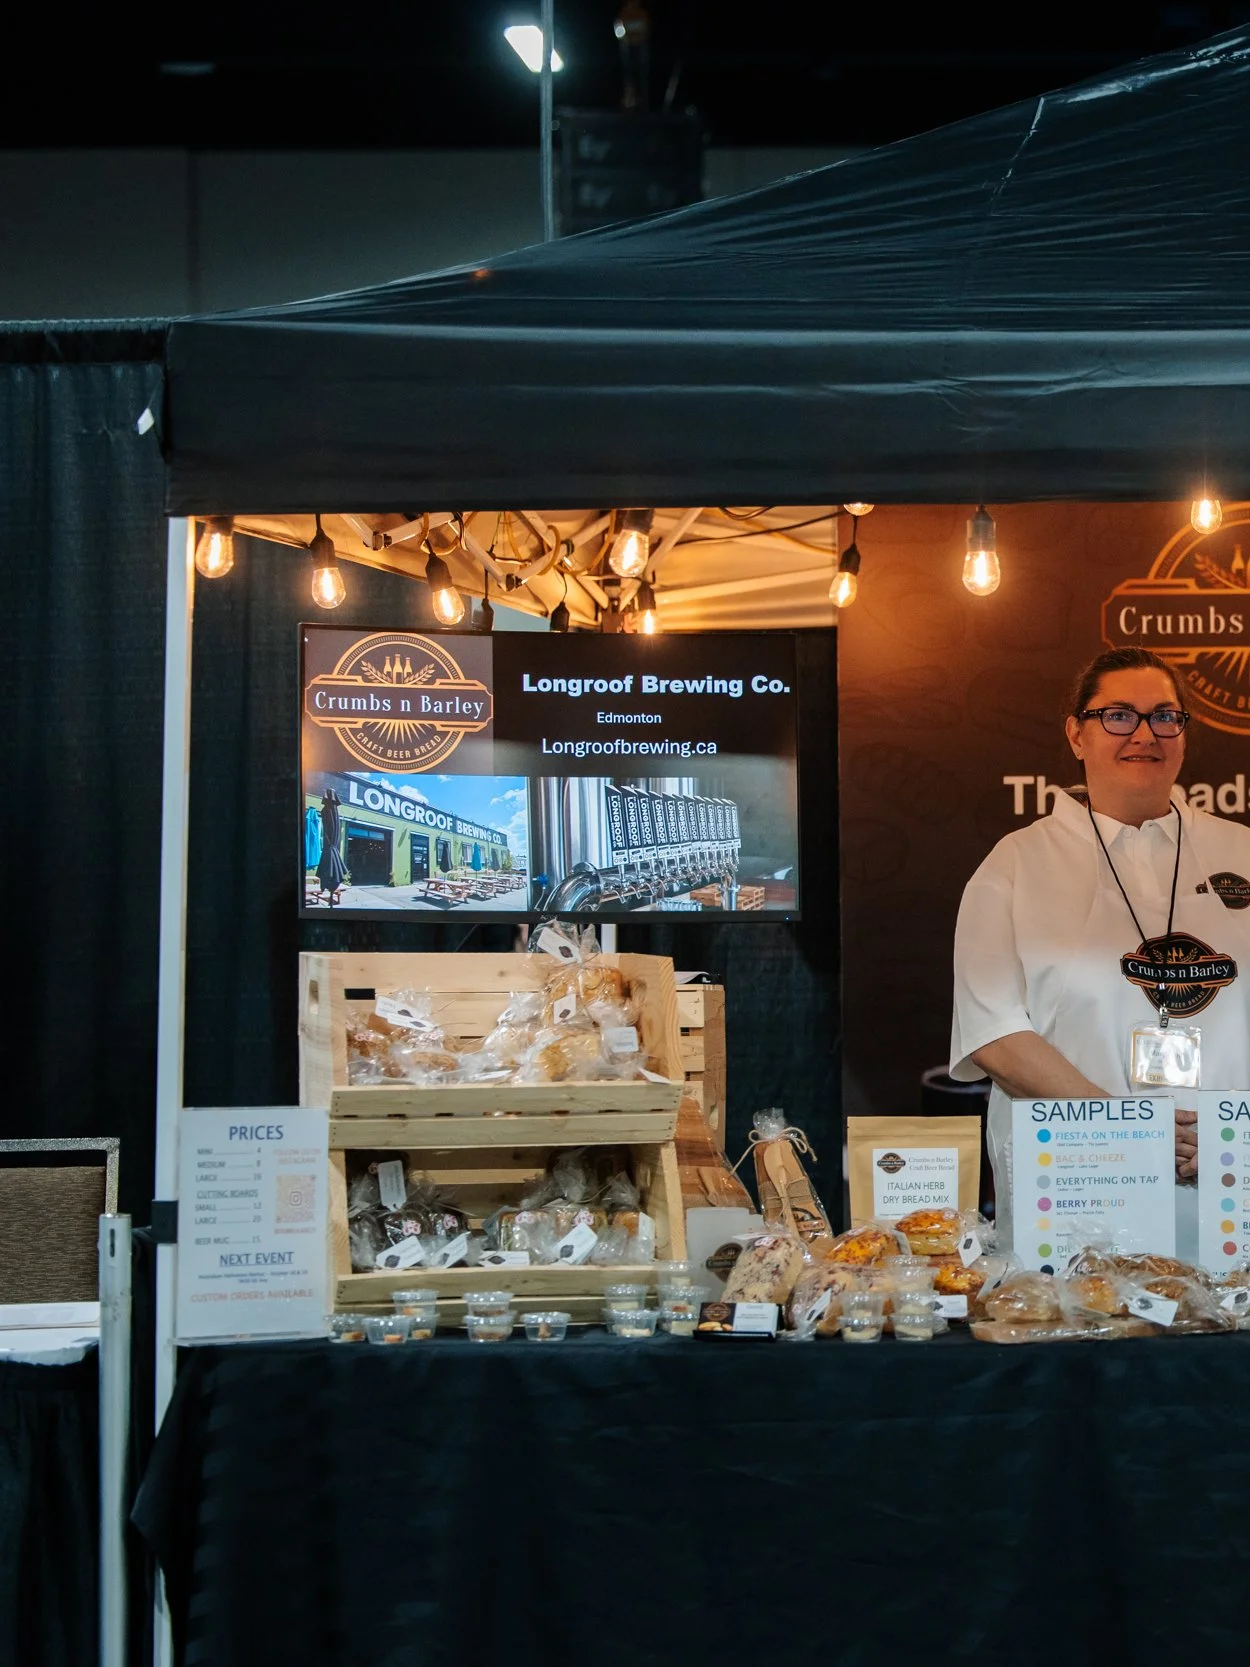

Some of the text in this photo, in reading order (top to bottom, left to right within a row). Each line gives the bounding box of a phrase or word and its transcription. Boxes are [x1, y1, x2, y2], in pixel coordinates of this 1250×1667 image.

[1119, 606, 1244, 635] Crumbs
[523, 674, 790, 698] Longroof Brewing Co.
[1188, 669, 1230, 704] CRAFT
[315, 691, 483, 719] Crumbs n Barley
[597, 712, 662, 724] Edmonton
[356, 732, 441, 759] CRAFT BEER BREAD
[542, 738, 717, 758] Longroofbrewing.ca
[1003, 775, 1088, 815] Th
[350, 780, 453, 830] LONGROOF
[456, 821, 492, 842] BREWING
[611, 796, 623, 847] LONGROOF
[627, 796, 639, 847] LONGROOF
[640, 798, 652, 845] LONGROOF
[655, 799, 666, 843] LONGROOF
[668, 800, 677, 843] LONGROOF
[677, 801, 688, 840] LONGROOF
[1179, 969, 1186, 978] n
[1190, 964, 1230, 978] Barley
[1031, 1100, 1154, 1122] SAMPLES
[229, 1125, 284, 1141] PRICES
[1056, 1130, 1165, 1140] FIESTA ON THE BEACH
[197, 1161, 226, 1169] MEDIUM
[1088, 1154, 1126, 1162] CHEEZE
[196, 1174, 218, 1182] LARGE
[1056, 1176, 1159, 1186] EVERYTHING ON TAP
[888, 1181, 944, 1191] ITALIAN HERB
[196, 1189, 259, 1199] CUTTING BOARDS
[883, 1195, 950, 1204] DRY BREAD MIX
[195, 1204, 217, 1212] SMALL
[1056, 1199, 1125, 1208] BERRY PROUD
[195, 1217, 217, 1225] LARGE
[195, 1237, 212, 1245] BEER
[220, 1252, 294, 1266] NEXT EVENT
[191, 1293, 228, 1302] CUSTOM
[268, 1288, 313, 1298] AVAILABLE
